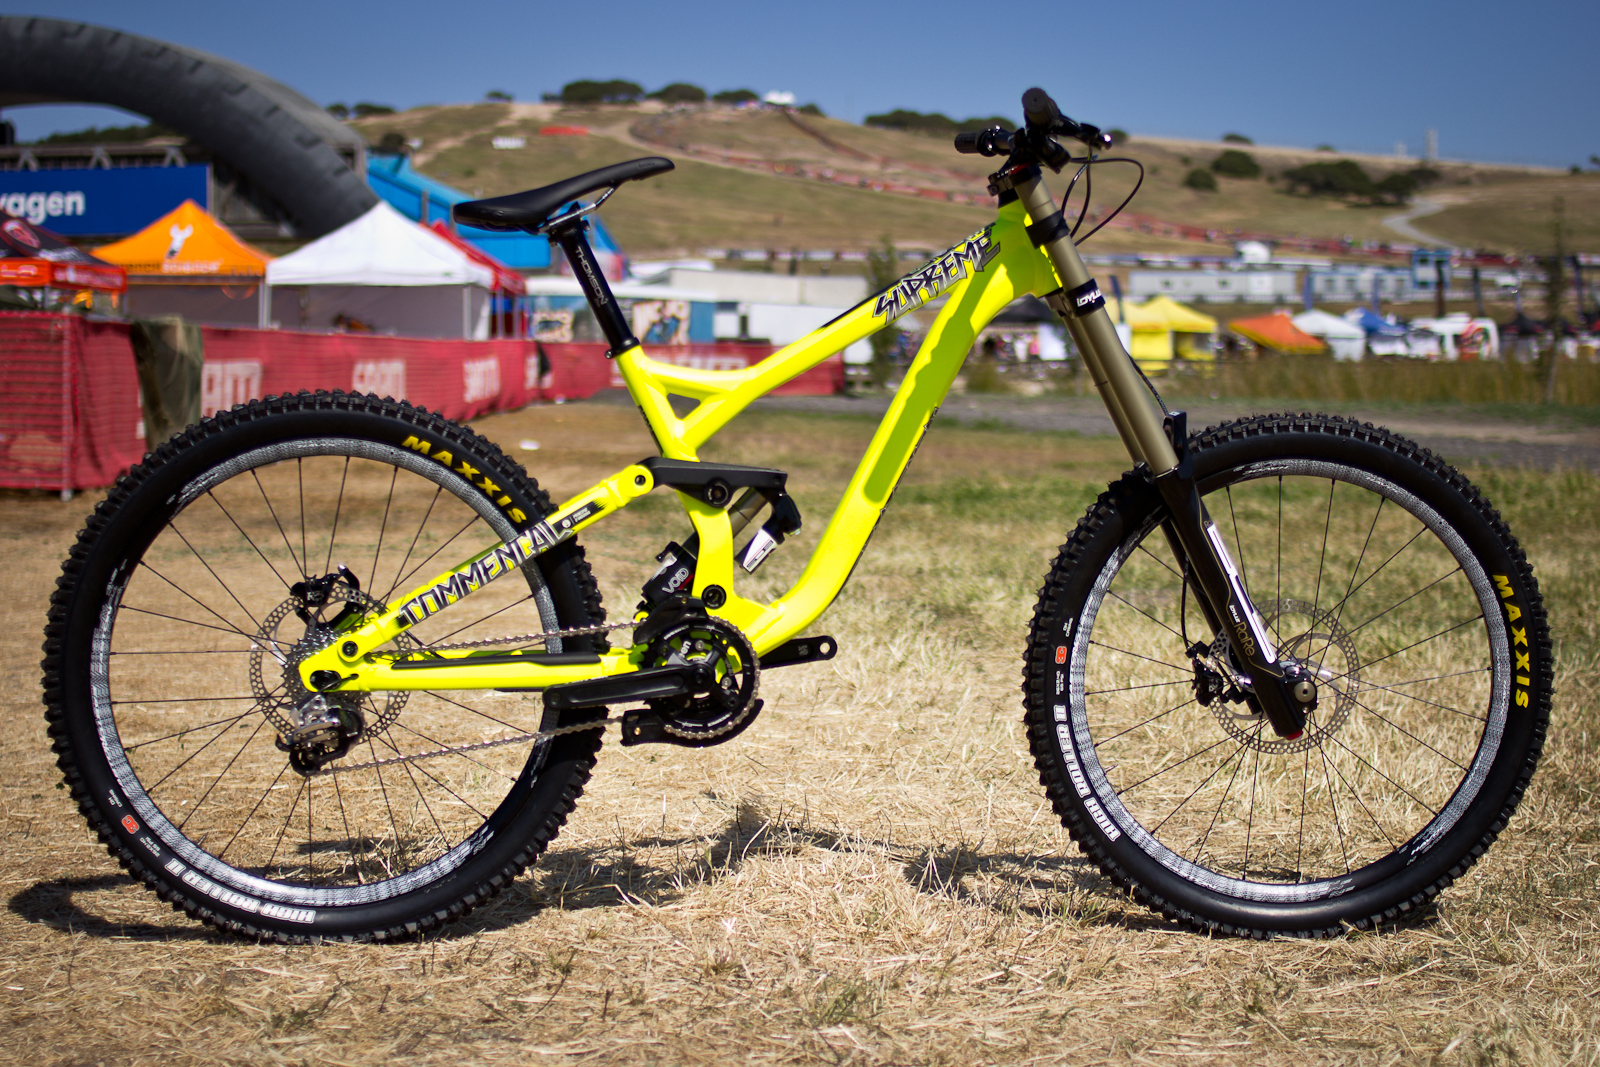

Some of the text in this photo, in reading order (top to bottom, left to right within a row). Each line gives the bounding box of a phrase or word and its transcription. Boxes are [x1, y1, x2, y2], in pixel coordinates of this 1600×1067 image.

[575, 245, 608, 305] THOMSON
[872, 228, 1001, 325] SUPREME
[402, 435, 528, 523] MAXXIS
[661, 567, 690, 594] VOID
[1492, 574, 1531, 709] MAXXIS
[1053, 704, 1121, 842] HIGH ROLLER II
[164, 858, 317, 924] HIGH ROLLER II
